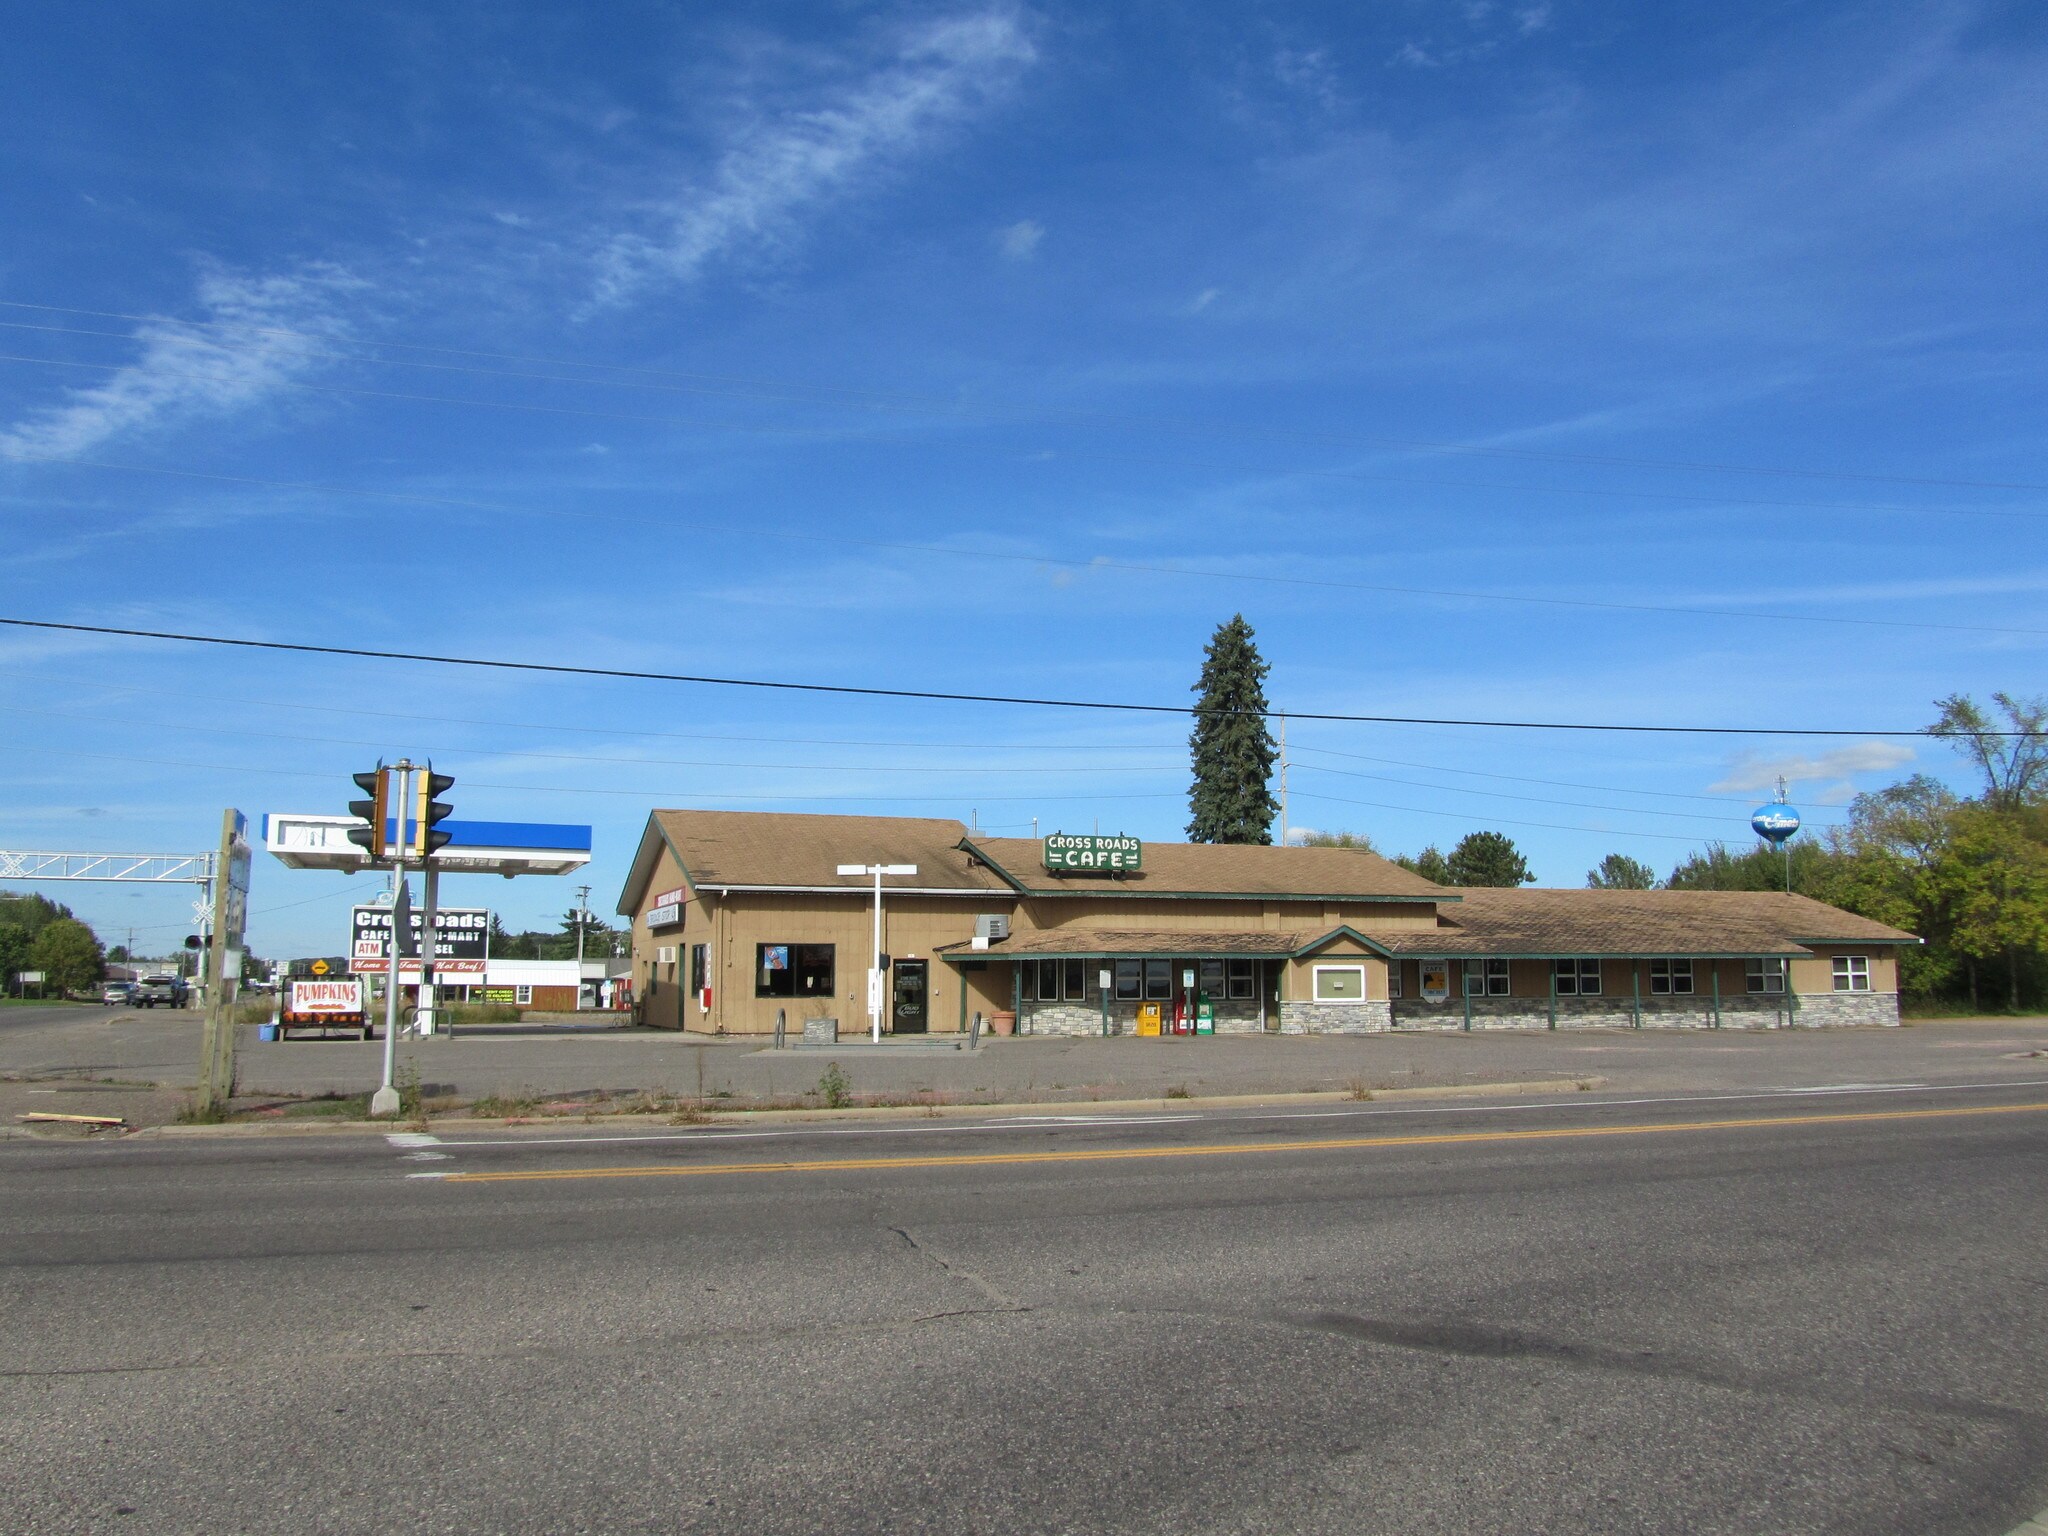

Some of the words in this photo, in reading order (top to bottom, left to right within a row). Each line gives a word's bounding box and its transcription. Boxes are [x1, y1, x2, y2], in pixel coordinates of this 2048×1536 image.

[1048, 837, 1092, 849] CROSS
[1096, 838, 1138, 851] ROADS
[1065, 850, 1123, 867] CAFE
[361, 930, 389, 940] CAFE
[358, 943, 378, 954] ATM
[416, 944, 454, 954] DSEL
[296, 984, 357, 1003] PUMPKINS
